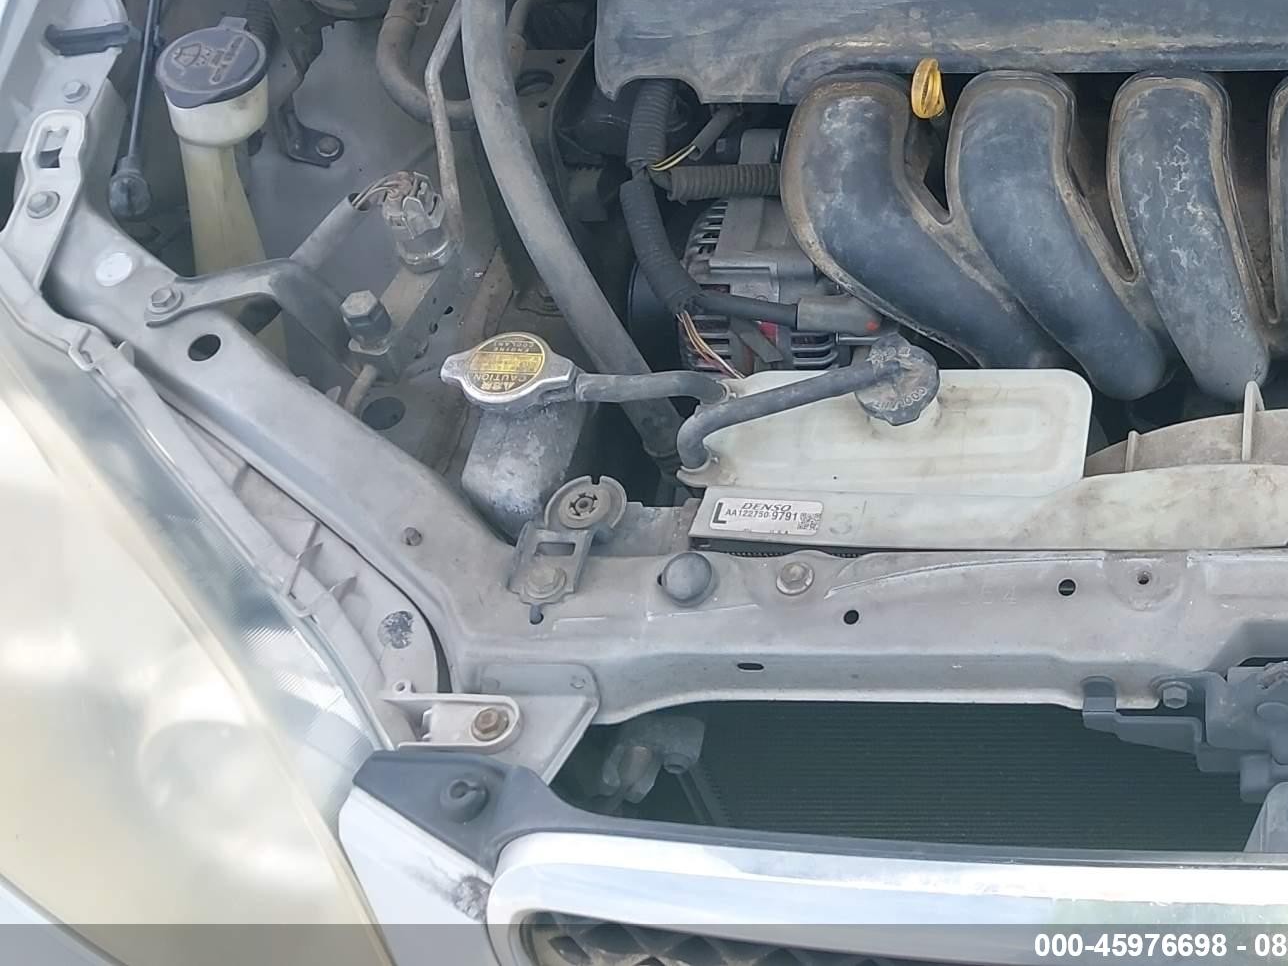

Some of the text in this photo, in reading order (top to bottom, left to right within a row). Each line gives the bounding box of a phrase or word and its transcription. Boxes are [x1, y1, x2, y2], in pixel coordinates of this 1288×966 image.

[473, 373, 527, 382] CAUTION
[741, 502, 792, 512] DENSO
[711, 501, 727, 524] L
